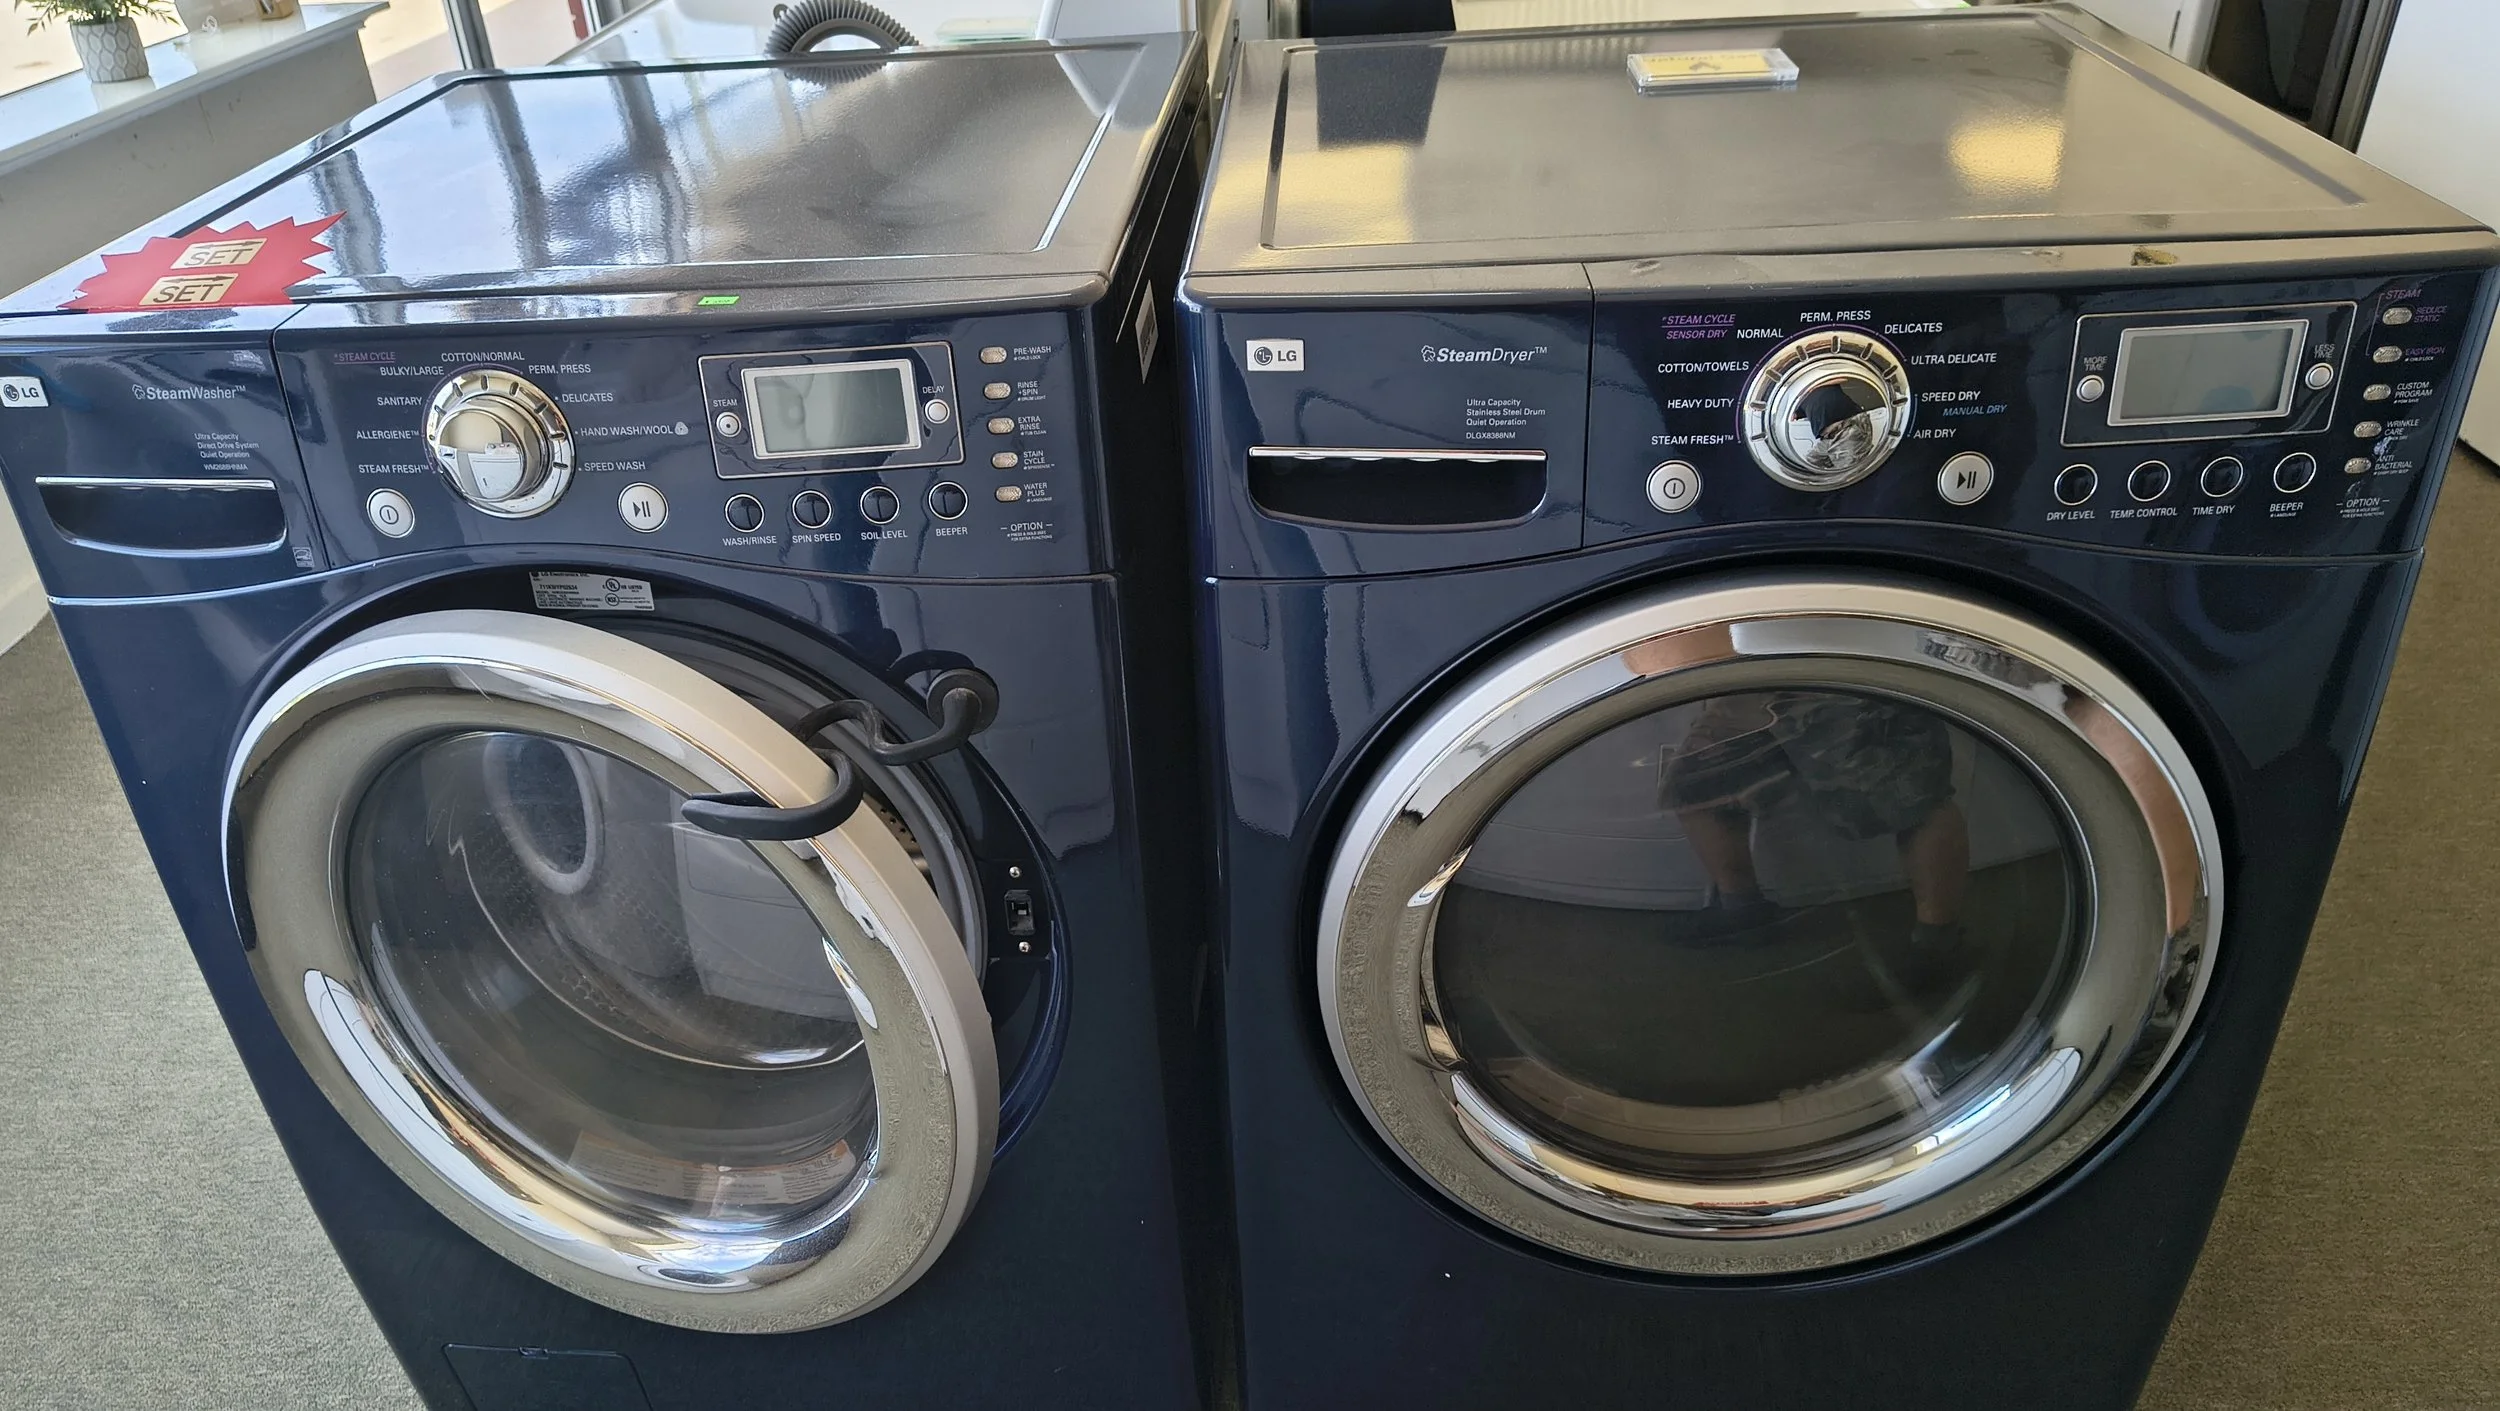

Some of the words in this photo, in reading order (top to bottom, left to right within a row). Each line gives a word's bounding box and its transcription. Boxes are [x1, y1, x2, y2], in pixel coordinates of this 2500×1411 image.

[184, 248, 253, 266] SET
[153, 283, 223, 303] SET
[2386, 289, 2422, 299] STEAM
[1704, 314, 1736, 323] CYCLE
[1800, 311, 1833, 322] PERM.
[1836, 310, 1871, 321] PRESS
[1737, 328, 1784, 339] NORMAL
[1884, 323, 1943, 334] DELICATES
[1666, 330, 1705, 339] SENSOR
[1707, 329, 1728, 339] DRY
[1014, 346, 1051, 355] PRE-WASH
[370, 352, 396, 361] CYCLE
[441, 350, 525, 362] COTTON/NORMAL
[1278, 351, 1297, 362] LG
[1911, 354, 1945, 365] ULTRA
[1947, 353, 1997, 364] DELICATE
[380, 366, 444, 376] BULKY/LARGE
[528, 364, 559, 374] PERM.
[561, 363, 591, 373] PRESS
[1657, 361, 1749, 373] COTTON/TOWELS
[922, 385, 945, 394] DELAY
[1017, 381, 1038, 389] RINSE
[2396, 381, 2430, 390] CUSTOM
[21, 387, 40, 398] LG
[562, 392, 613, 403] DELICATES
[1921, 391, 1955, 402] SPEED
[1958, 390, 1981, 401] DRY
[2394, 389, 2433, 398] PROGRAM
[377, 396, 422, 406] SANITARY
[713, 398, 738, 407] STEAM
[1488, 398, 1521, 407] Capacity
[1667, 399, 1701, 409] HEAVY
[1705, 398, 1735, 409] DUTY
[1466, 408, 1501, 416] Stainless
[1502, 408, 1522, 416] Steel
[1942, 406, 1984, 416] MANUAL
[1985, 404, 2007, 414] DRY
[1018, 416, 1041, 424] EXTRA
[1466, 418, 1487, 426] Quiet
[1488, 418, 1527, 427] Operation
[2387, 419, 2420, 427] WRINKLE
[580, 426, 608, 436] HAND
[610, 425, 674, 436] WASH/WOOL
[1020, 423, 1040, 431] RINSE
[2385, 428, 2405, 436] CARE
[211, 432, 239, 441] Capacity
[1913, 429, 1931, 440] AIR
[1933, 428, 1957, 439] DRY
[1651, 435, 1688, 445] STEAM
[197, 441, 217, 449] Direct
[217, 441, 234, 449] Drive
[235, 441, 260, 450] System
[218, 450, 250, 459] Operation
[1023, 450, 1043, 458] STAIN
[2376, 454, 2395, 462] ANTI
[1024, 457, 1045, 465] CYCLE
[2375, 461, 2412, 470] BACTERIAL
[358, 464, 388, 474] STEAM
[584, 462, 614, 472] SPEED
[616, 461, 646, 471] WASH
[1024, 482, 1047, 490] WATER
[1027, 489, 1045, 497] PLUS
[2269, 502, 2304, 512] BEEPER
[2346, 498, 2380, 508] OPTION
[2110, 509, 2134, 519] TEMP.
[2136, 507, 2178, 518] CONTROL
[2192, 506, 2215, 516] TIME
[2216, 504, 2236, 515] DRY
[2046, 511, 2067, 521] DRY
[2068, 510, 2095, 520] LEVEL
[1011, 521, 1043, 531] OPTION
[861, 531, 880, 540] SOIL
[882, 530, 907, 539] LEVEL
[935, 526, 968, 537] BEEPER
[722, 535, 777, 546] WASH/RINSE
[792, 534, 813, 544] SPIN
[814, 533, 841, 543] SPEED
